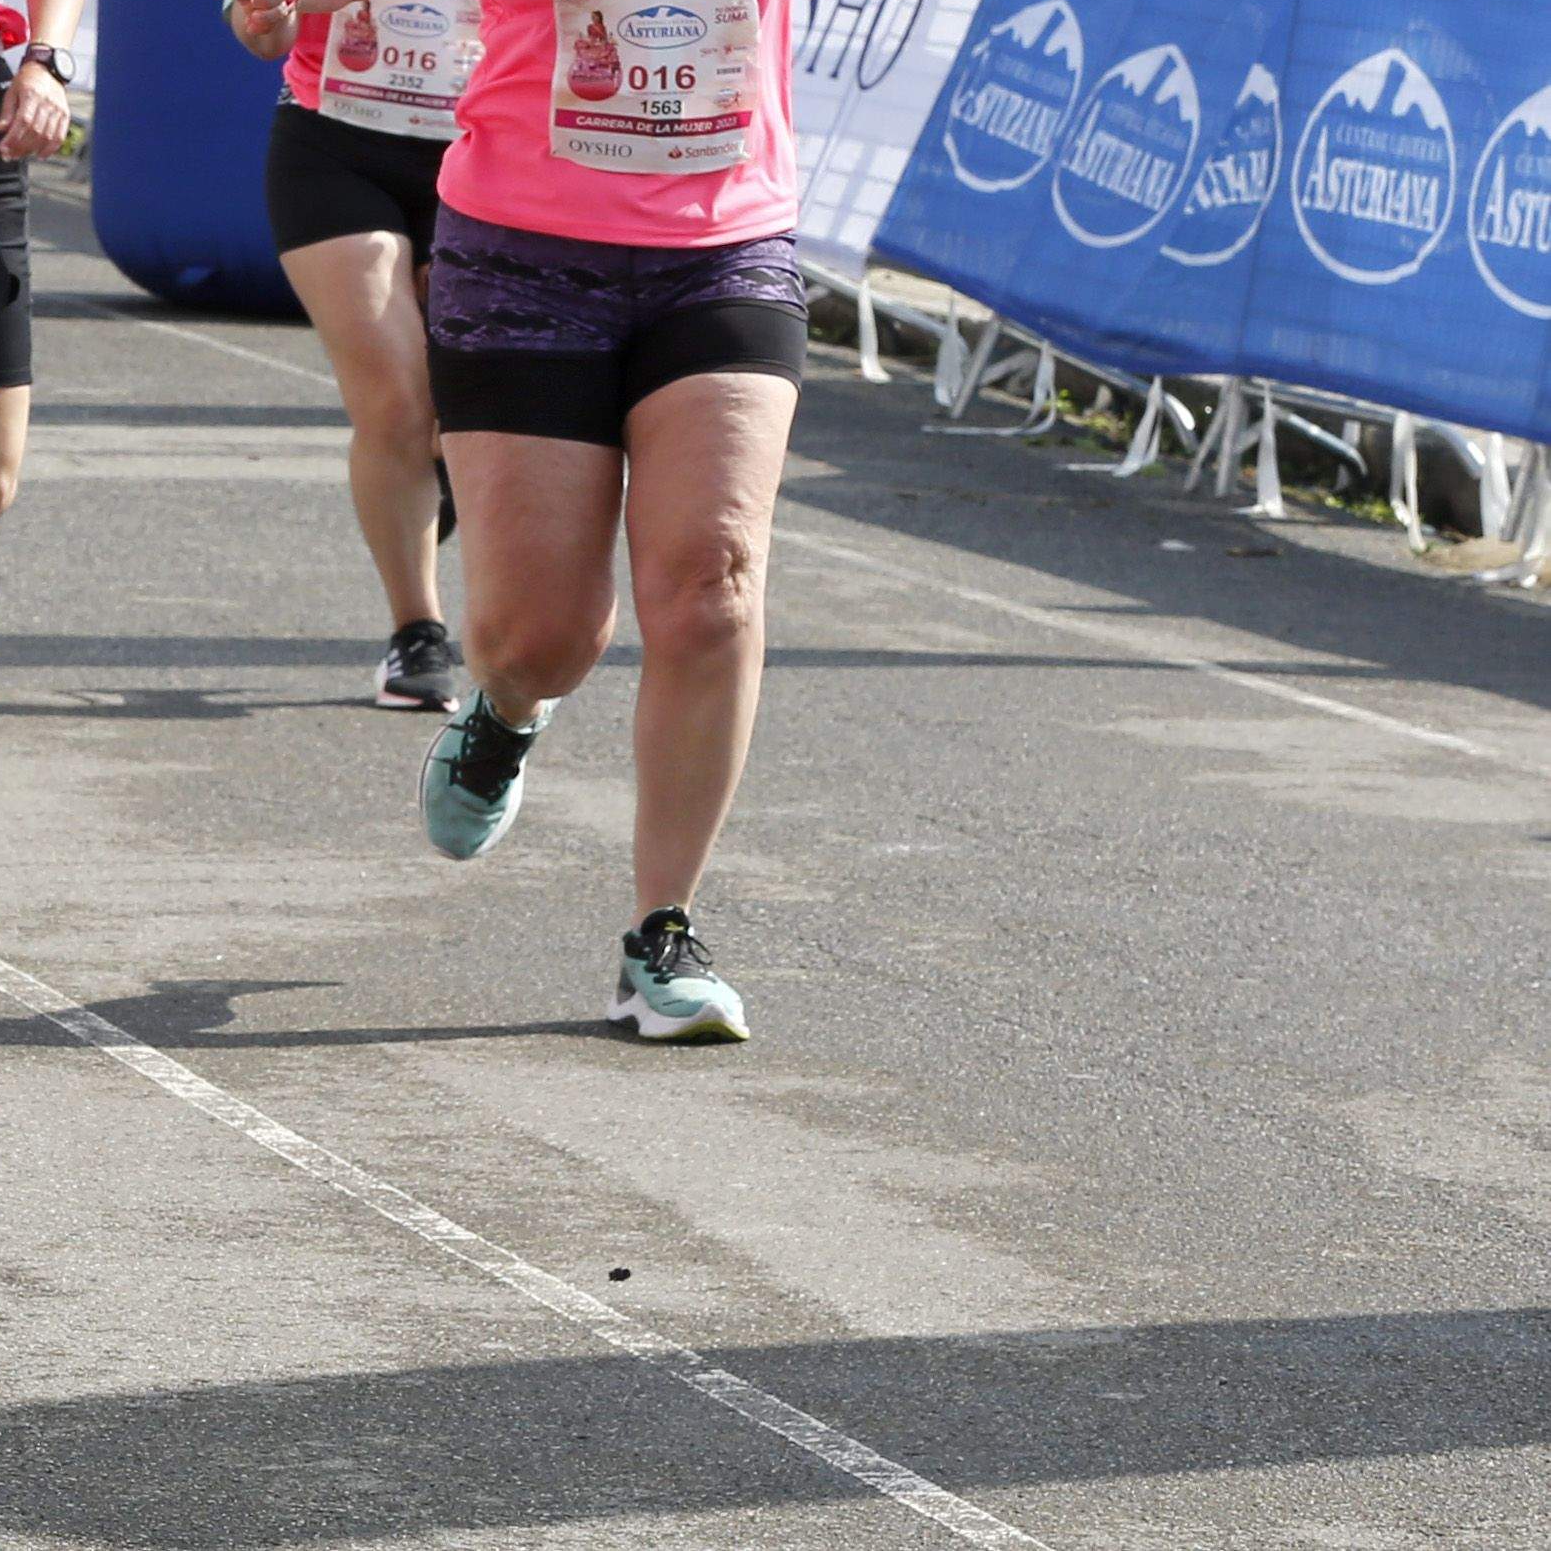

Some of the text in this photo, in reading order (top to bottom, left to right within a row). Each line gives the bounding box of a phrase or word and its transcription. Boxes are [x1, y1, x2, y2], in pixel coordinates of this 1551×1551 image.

[624, 22, 700, 39] ASTURIANA
[382, 45, 438, 72] 016
[628, 65, 697, 91] 016
[640, 99, 683, 116] 1563
[575, 115, 633, 131] CARRERA
[636, 122, 654, 133] DE
[655, 123, 671, 133] LA
[672, 121, 713, 133] MUJER
[568, 137, 633, 160] OYSHO
[1301, 125, 1440, 233] ASTURIANA
